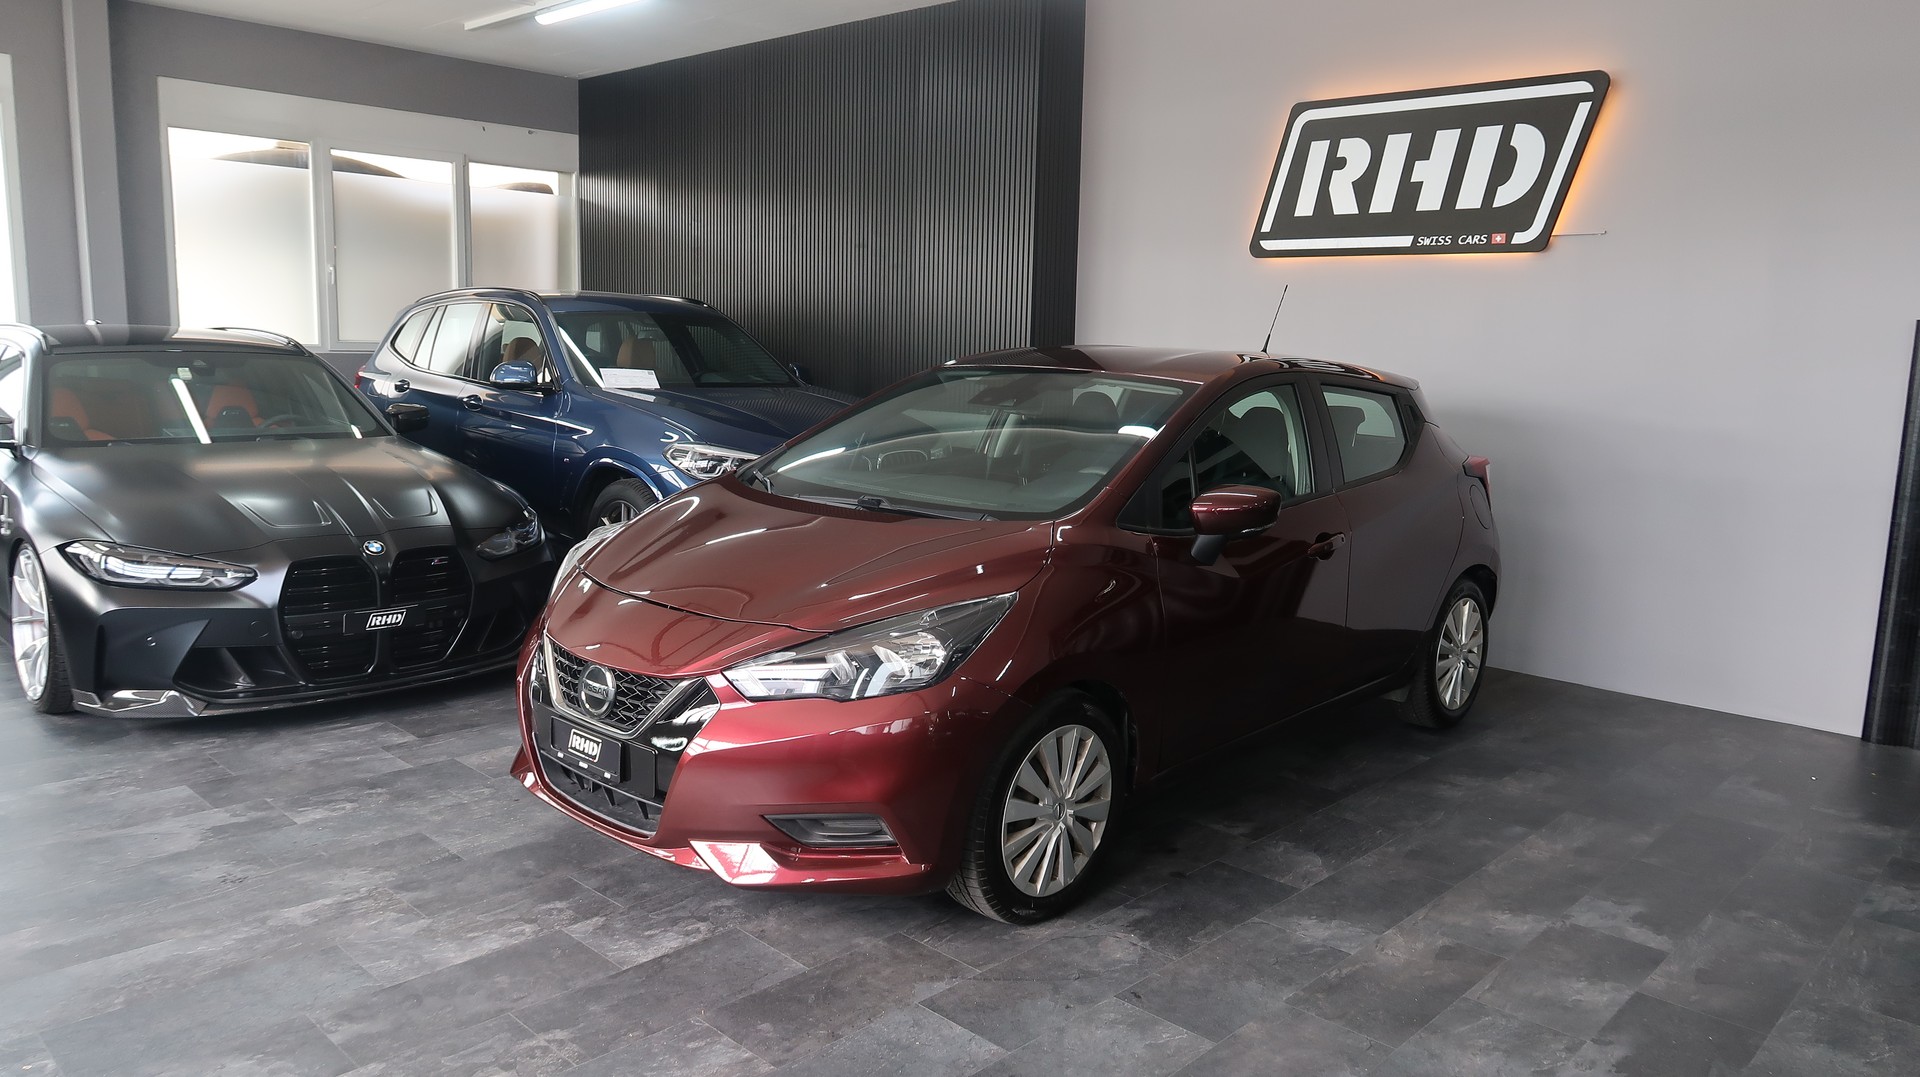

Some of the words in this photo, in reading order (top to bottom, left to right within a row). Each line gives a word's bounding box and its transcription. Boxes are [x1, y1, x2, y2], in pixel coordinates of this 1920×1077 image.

[1294, 123, 1545, 217] RHD
[1416, 236, 1452, 246] SWISS
[1458, 234, 1488, 245] CARS
[371, 614, 402, 626] RHD
[571, 734, 598, 756] RHD
